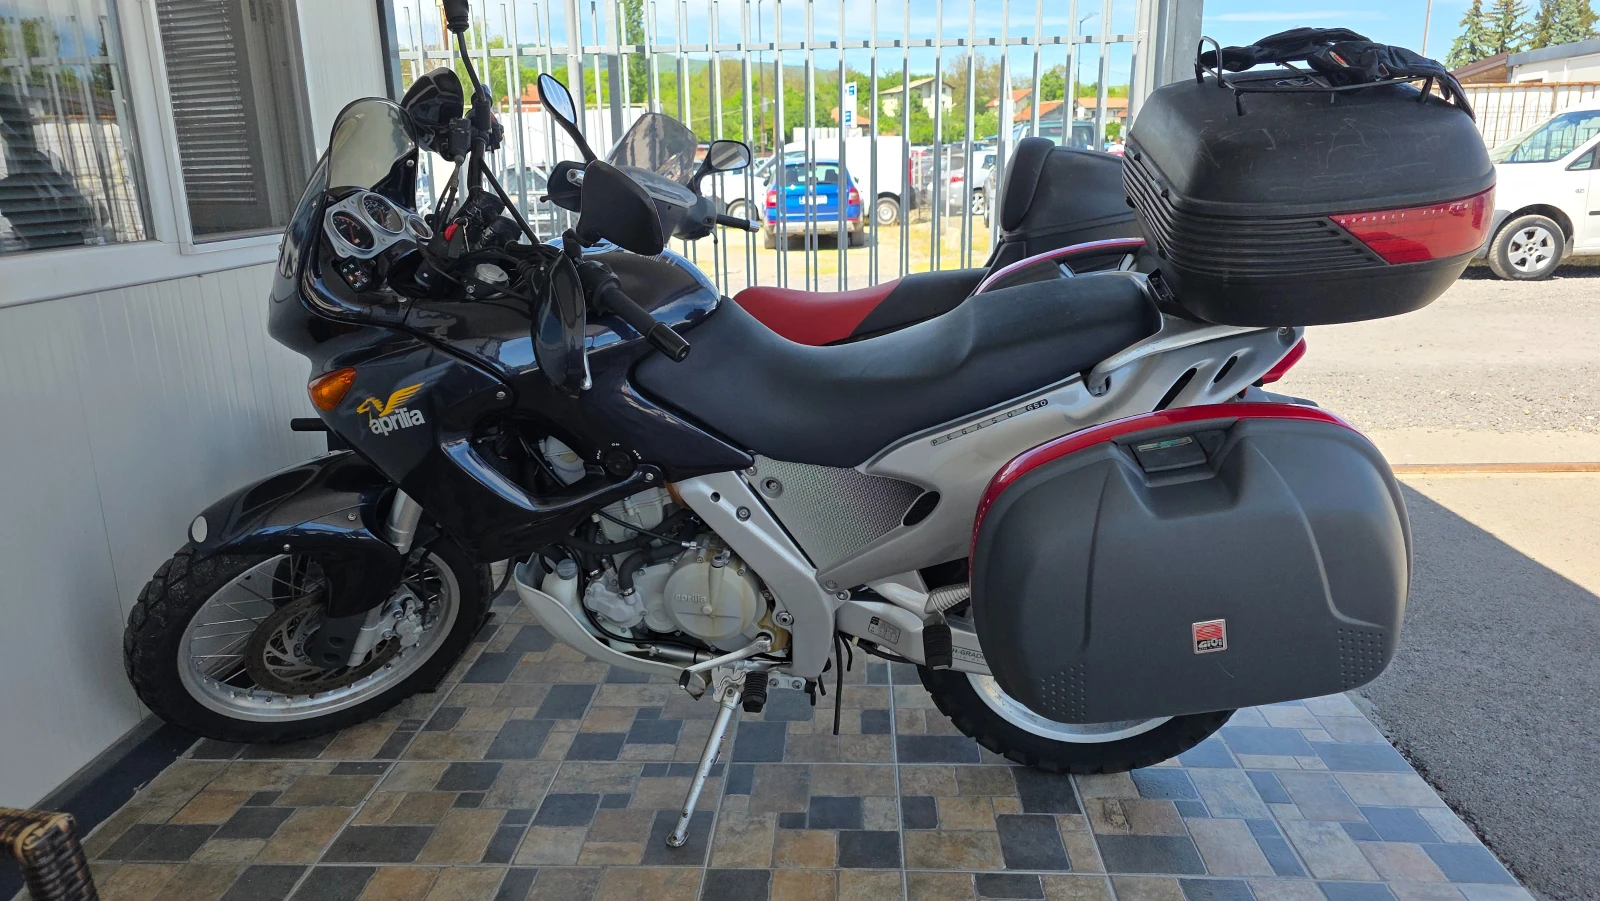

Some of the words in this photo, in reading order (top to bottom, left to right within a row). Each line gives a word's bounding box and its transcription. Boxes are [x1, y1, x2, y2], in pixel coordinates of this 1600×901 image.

[370, 407, 426, 436] aprilia
[931, 411, 1013, 446] PEGASO
[1026, 399, 1047, 411] 650
[675, 593, 707, 603] aprilia
